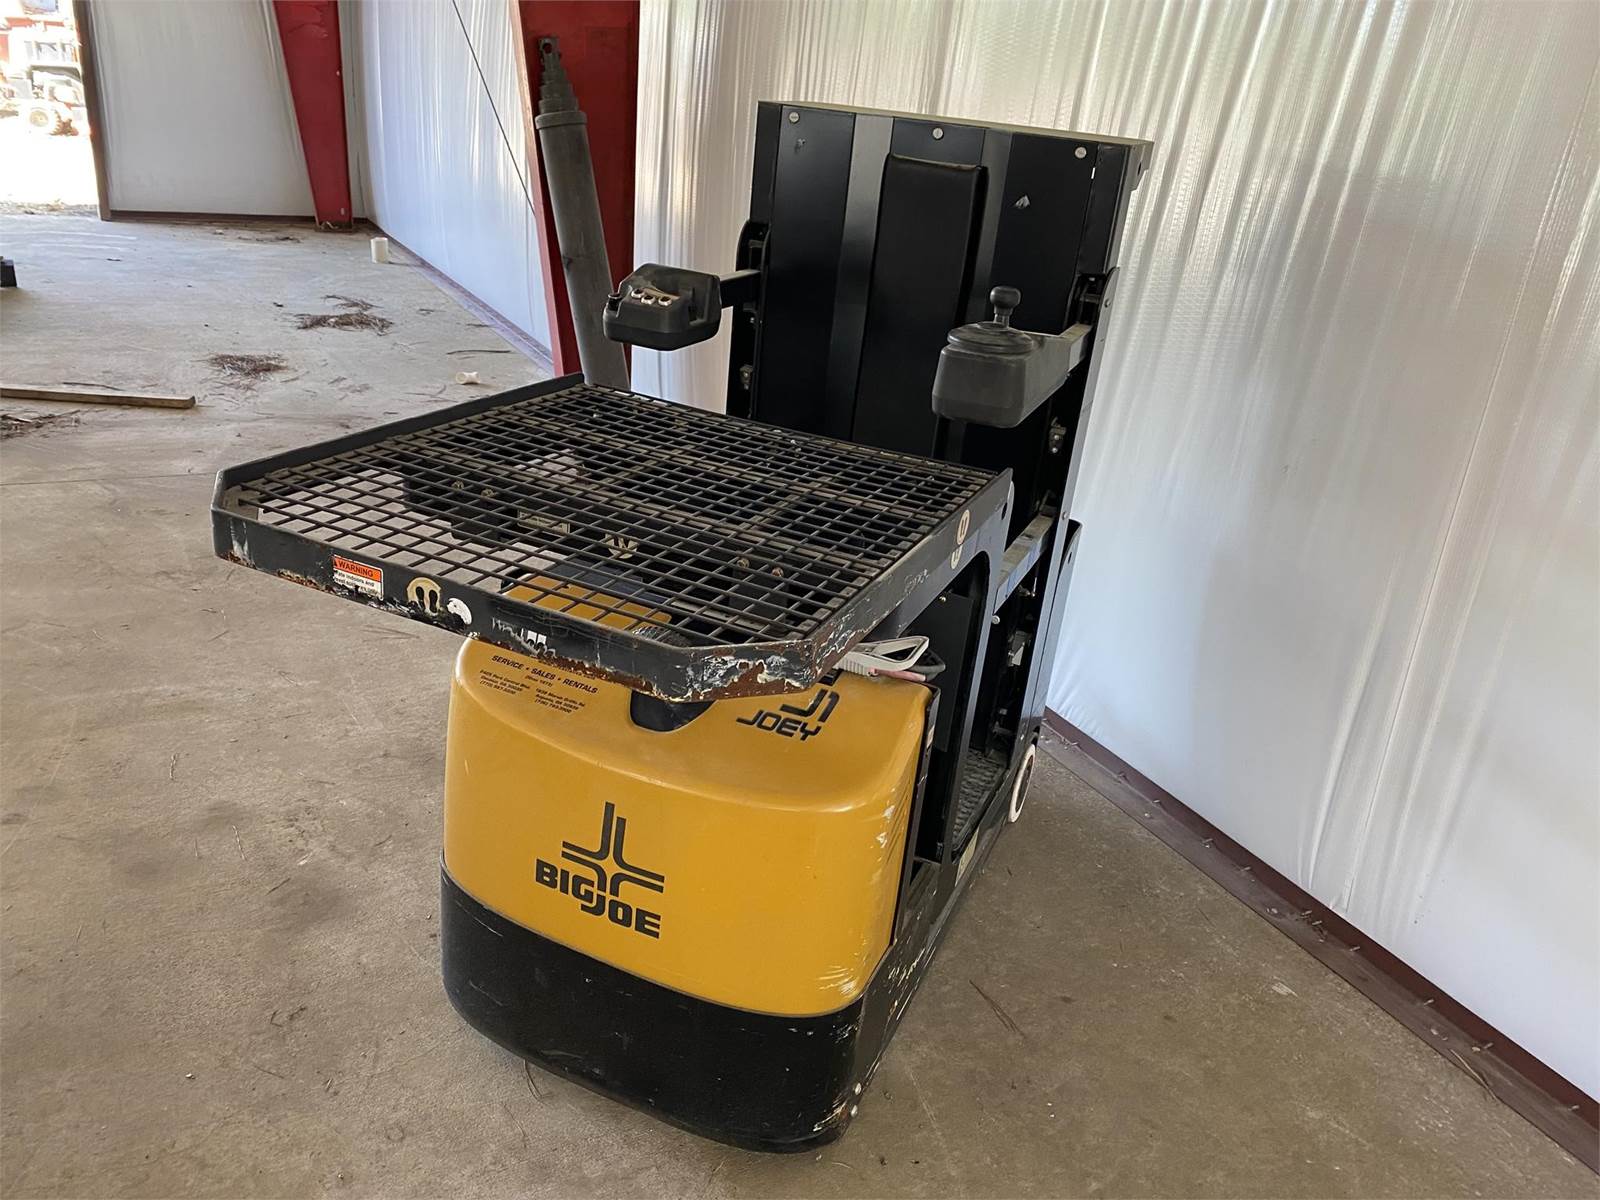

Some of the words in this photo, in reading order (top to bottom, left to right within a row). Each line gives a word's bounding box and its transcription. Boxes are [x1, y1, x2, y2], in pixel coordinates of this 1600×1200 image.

[338, 560, 374, 577] WARNING
[491, 655, 525, 670] SERVICE
[530, 667, 556, 681] SALES
[562, 678, 599, 694] RENTALS
[736, 710, 822, 741] JOEY
